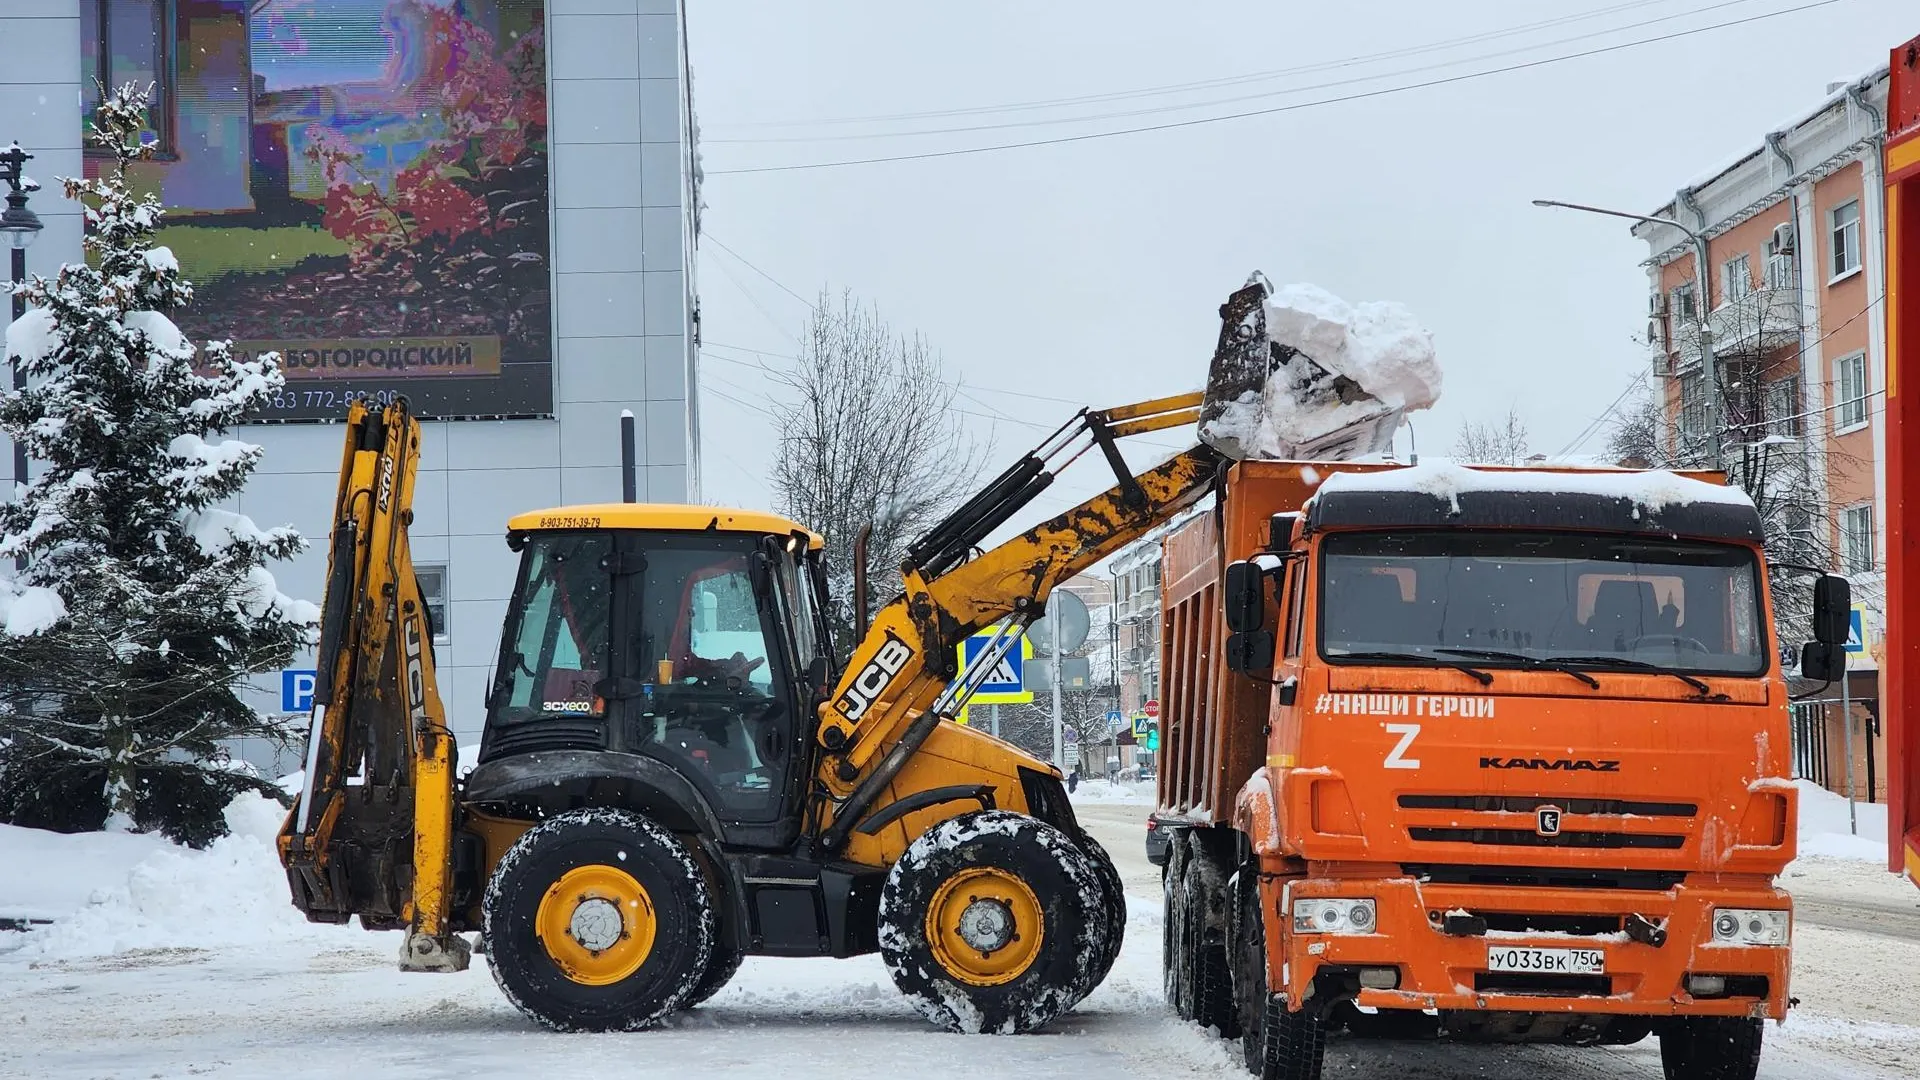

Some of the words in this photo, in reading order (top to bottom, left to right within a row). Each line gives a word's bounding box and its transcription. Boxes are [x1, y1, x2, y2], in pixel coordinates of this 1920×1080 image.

[287, 342, 472, 369] БОГОРОДСКИЙ
[265, 391, 297, 408] 63
[540, 517, 600, 528] 8-903-751-39-79
[845, 639, 910, 720] JCB
[294, 674, 316, 708] P
[543, 701, 590, 711] 3CXeco
[1315, 693, 1409, 715] #НАШИ
[1416, 696, 1495, 718] ГЕРОИ
[1384, 723, 1421, 769] Z
[1479, 757, 1620, 772] KAMAZ
[1571, 951, 1599, 965] 750
